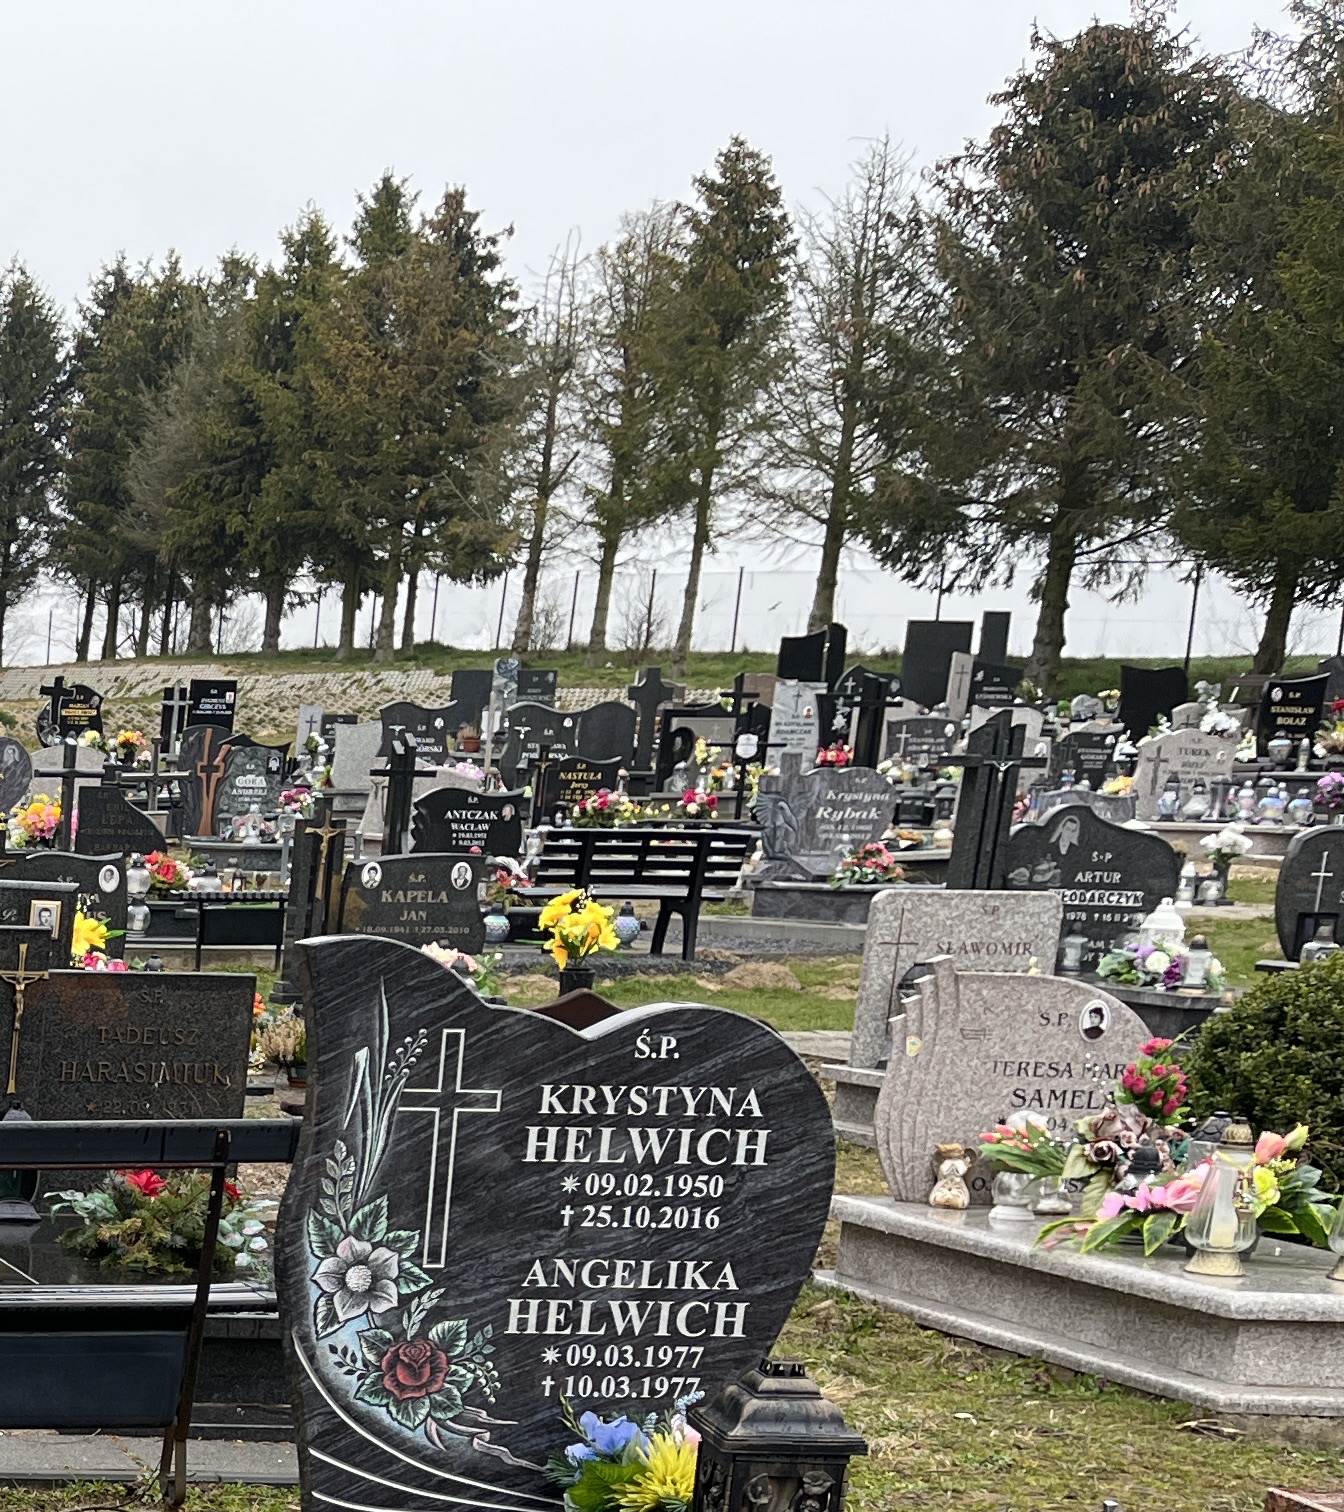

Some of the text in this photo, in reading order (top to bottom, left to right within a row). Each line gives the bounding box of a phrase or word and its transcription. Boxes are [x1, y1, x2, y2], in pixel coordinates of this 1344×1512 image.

[826, 790, 890, 802] Krystyna
[444, 810, 498, 820] ANTCZAK
[815, 806, 882, 822] Rybak
[1074, 871, 1122, 884] ARTUR
[381, 890, 449, 903] KAPELA
[1054, 889, 1144, 906] ŁODARCZYK
[400, 910, 427, 921] JAN
[936, 941, 1032, 956] SŁAWOMIR
[98, 1026, 200, 1045] TADEUSZ
[635, 1029, 680, 1060] Ś.P.
[60, 1061, 228, 1084] HARASIMIUK
[992, 1061, 1073, 1078] TERESA
[538, 1084, 765, 1118] KRYSTYNA
[1011, 1088, 1117, 1109] SAMELA
[521, 1125, 772, 1167] HELWICH
[585, 1174, 725, 1199] 09.02.1950
[580, 1205, 721, 1231] 25.10.2016
[522, 1259, 740, 1292] ANGELIKA
[504, 1298, 751, 1339] HELWICH
[566, 1345, 705, 1370] 09.03.1977
[564, 1375, 701, 1400] 10.03.1977
